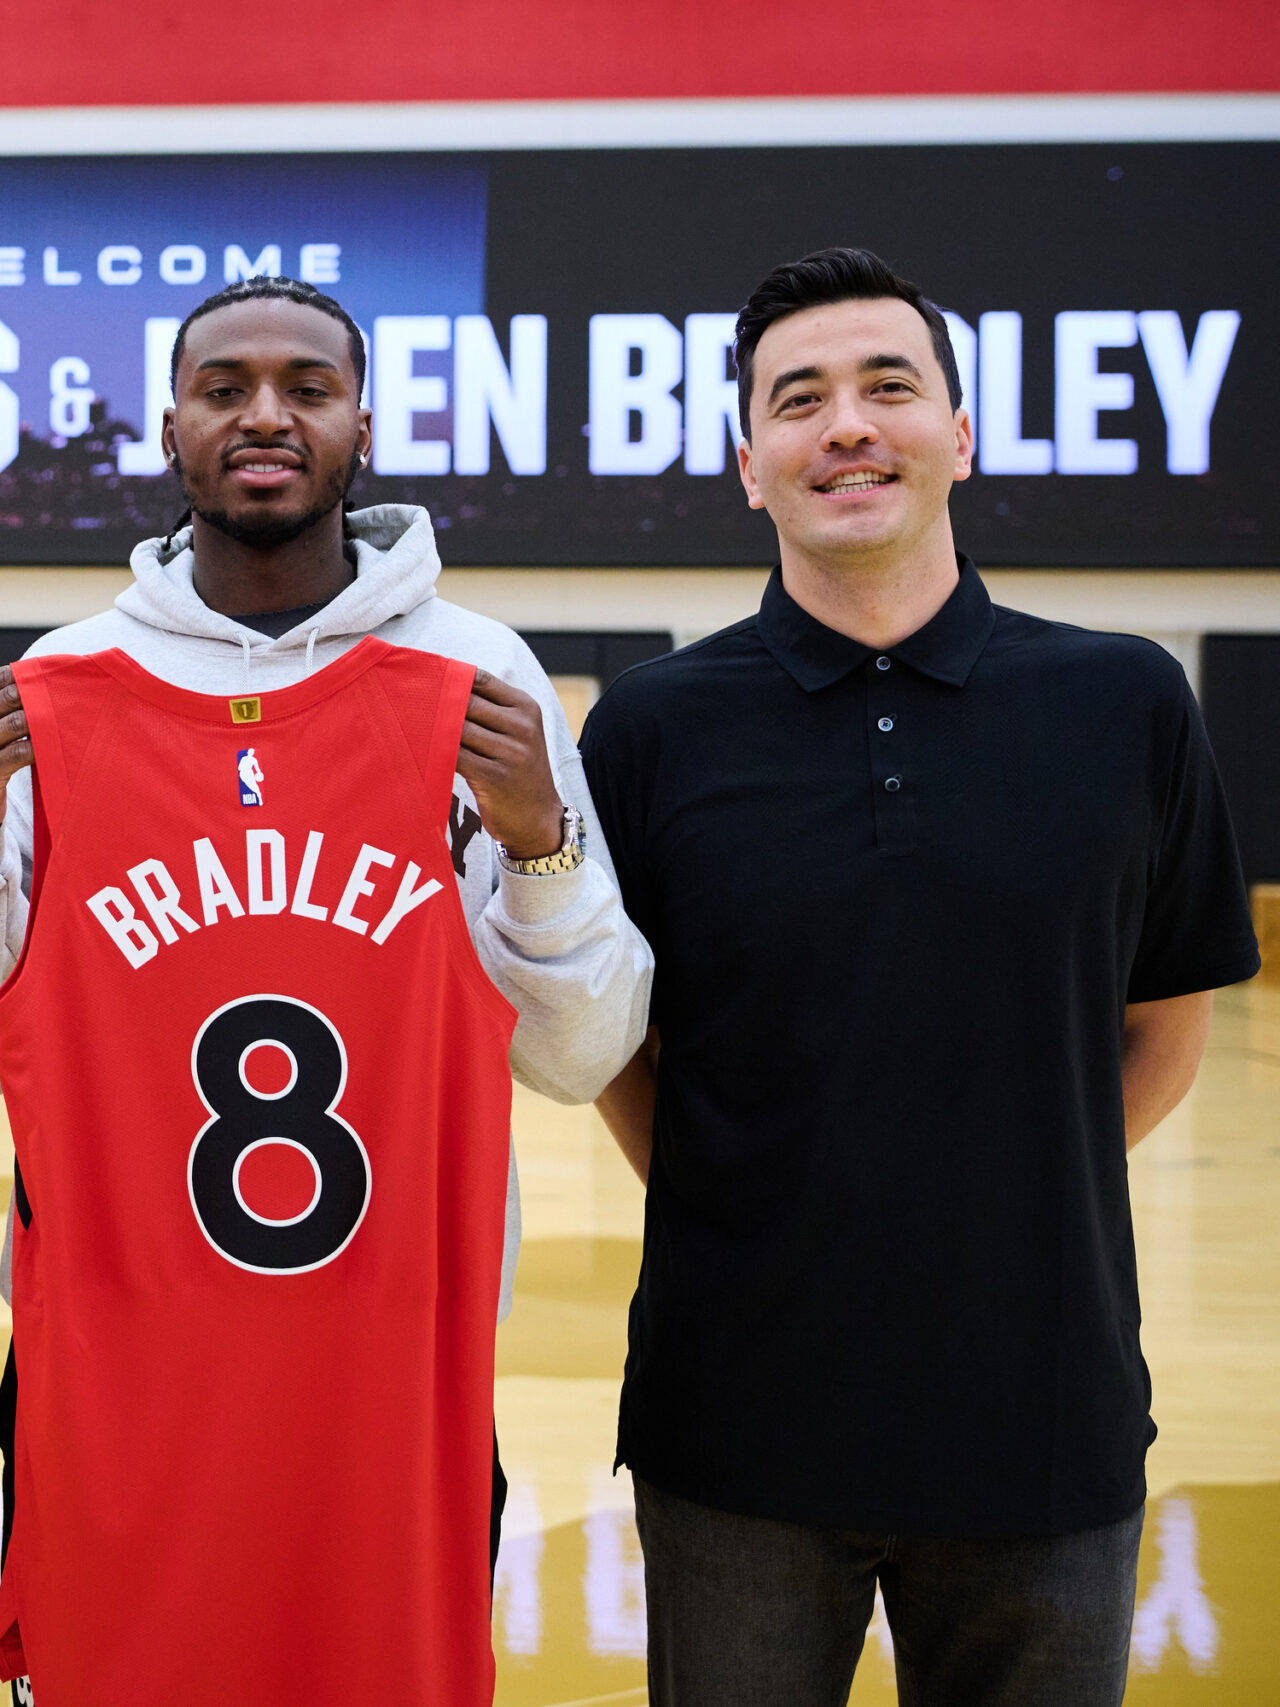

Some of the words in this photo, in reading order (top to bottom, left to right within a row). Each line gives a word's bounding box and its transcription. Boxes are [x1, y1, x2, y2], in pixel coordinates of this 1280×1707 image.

[50, 357, 95, 437] &
[117, 314, 547, 476] JEN
[588, 310, 1241, 475] BRLEY
[242, 793, 257, 805] NBA
[85, 828, 445, 970] BRADLEY
[186, 993, 373, 1276] 8
